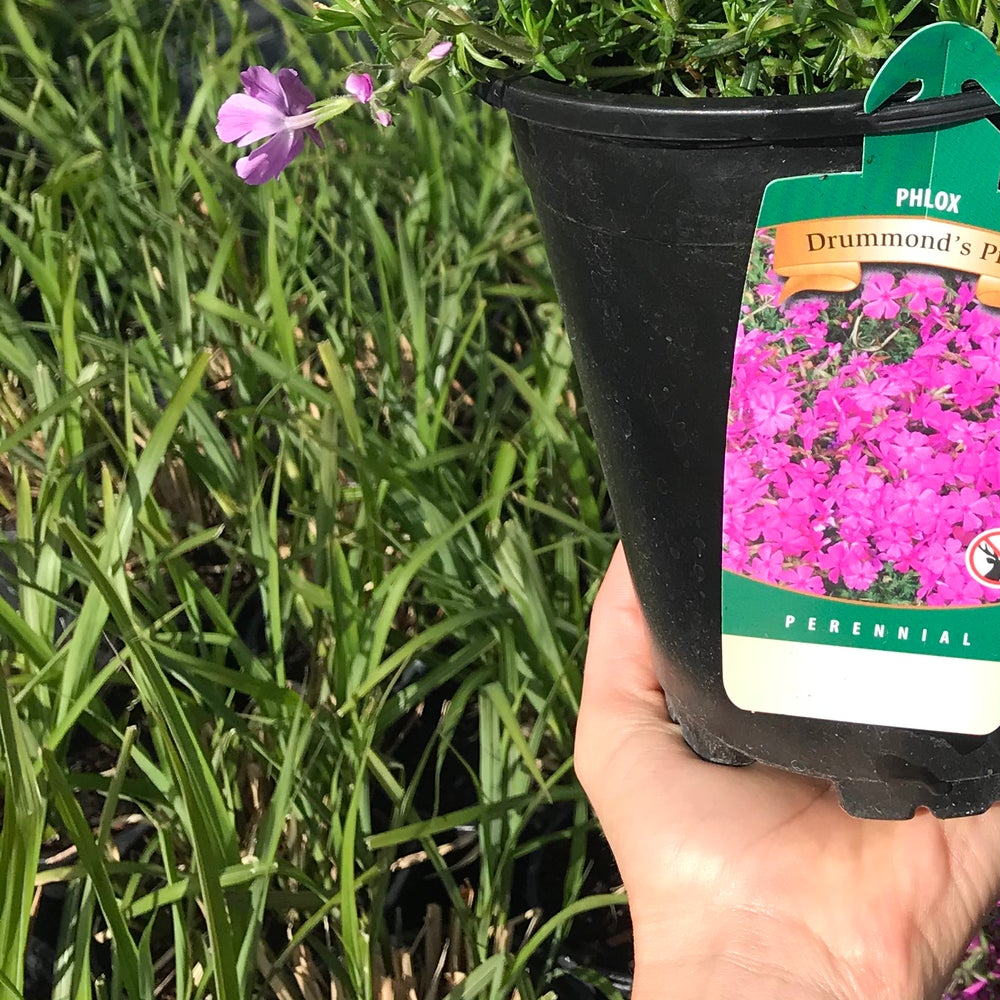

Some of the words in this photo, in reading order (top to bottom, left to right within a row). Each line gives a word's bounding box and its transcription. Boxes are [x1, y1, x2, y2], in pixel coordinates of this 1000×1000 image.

[895, 188, 961, 213] PHLOX
[806, 232, 971, 256] Drummond's
[785, 614, 971, 647] PERENNIAL
